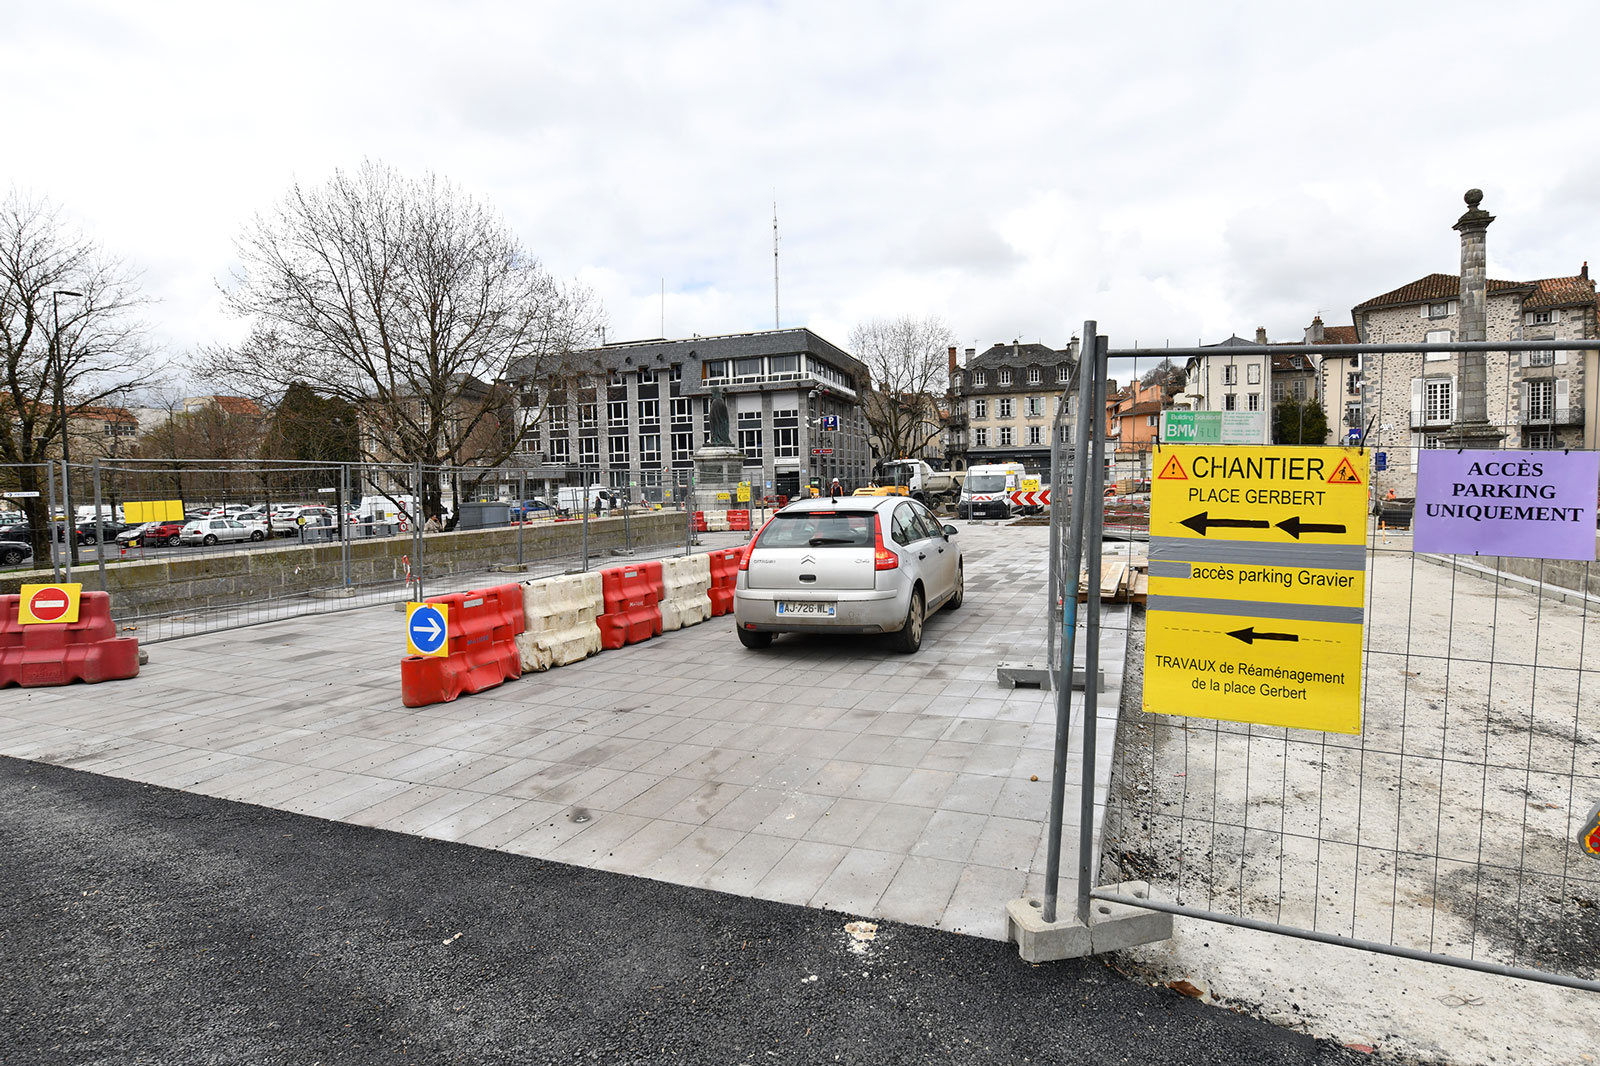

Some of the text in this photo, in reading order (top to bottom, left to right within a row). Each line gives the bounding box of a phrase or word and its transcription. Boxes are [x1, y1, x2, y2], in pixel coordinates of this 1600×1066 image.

[1170, 413, 1194, 422] Building
[1192, 455, 1325, 481] CHANTIER
[1467, 458, 1544, 477] ACCÈS
[1188, 487, 1326, 506] PLACE GERBERT
[1452, 483, 1556, 499] PARKING
[1425, 503, 1584, 522] UNIQUEMENT
[1192, 565, 1355, 588] accès parking Gravier
[1155, 655, 1345, 685] TRAVAUX de Réaménagement
[1191, 677, 1307, 700] de la place Gerbert
